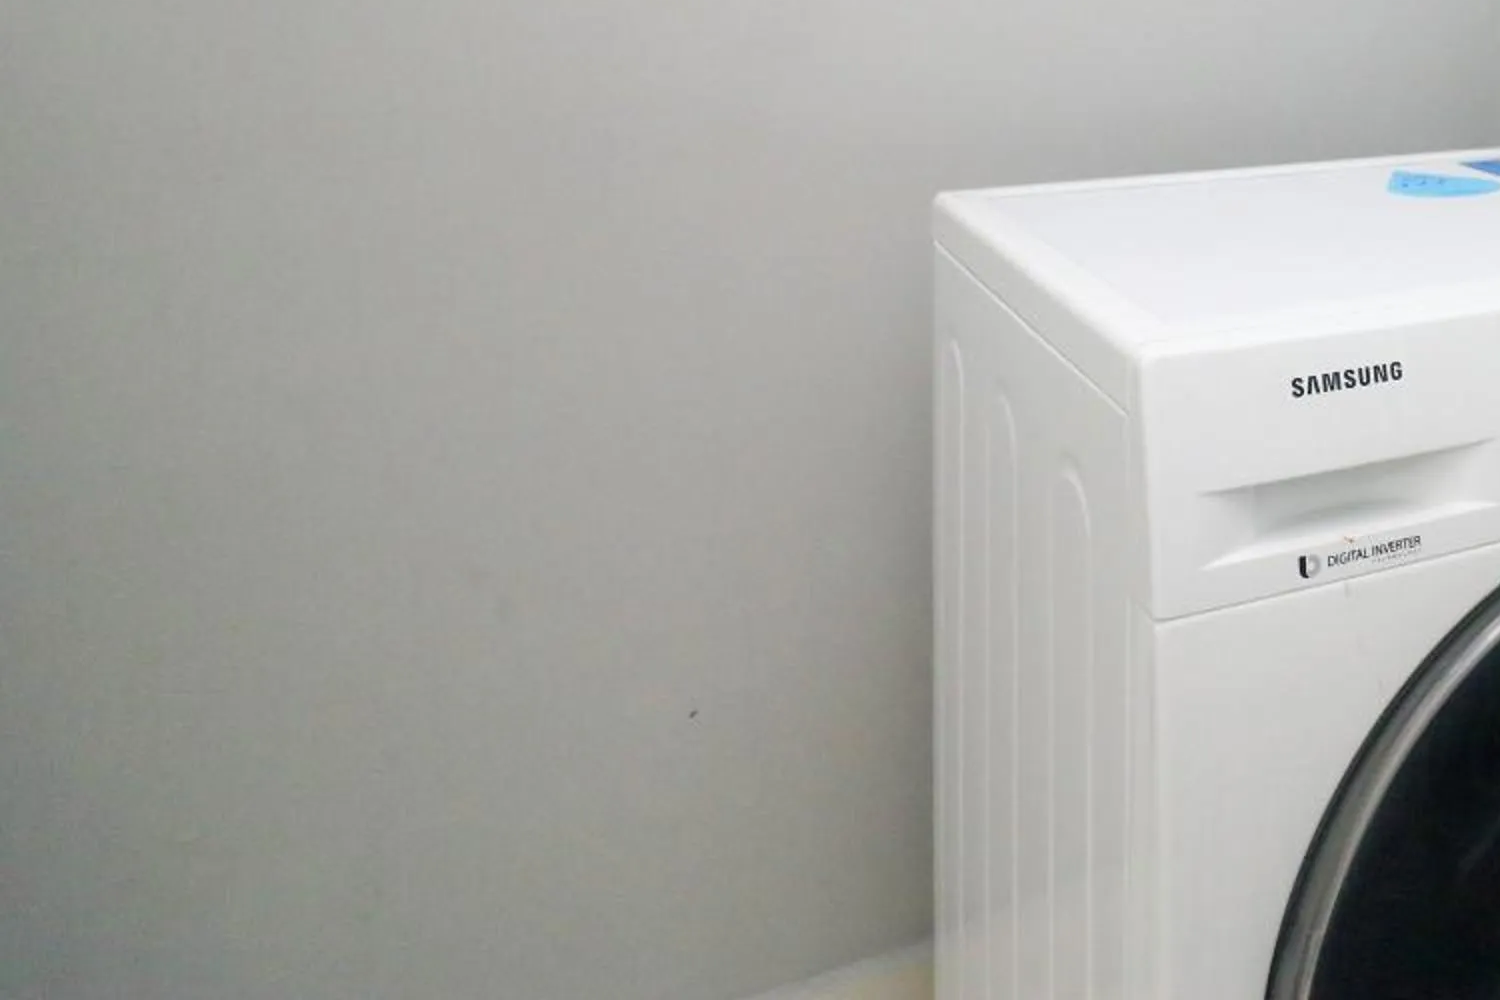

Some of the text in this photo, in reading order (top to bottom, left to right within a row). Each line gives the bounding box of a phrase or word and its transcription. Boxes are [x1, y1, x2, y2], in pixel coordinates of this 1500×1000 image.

[1291, 361, 1403, 398] SAMSUNG
[1327, 547, 1369, 568] DIGITAL
[1371, 535, 1422, 557] INVERTER
